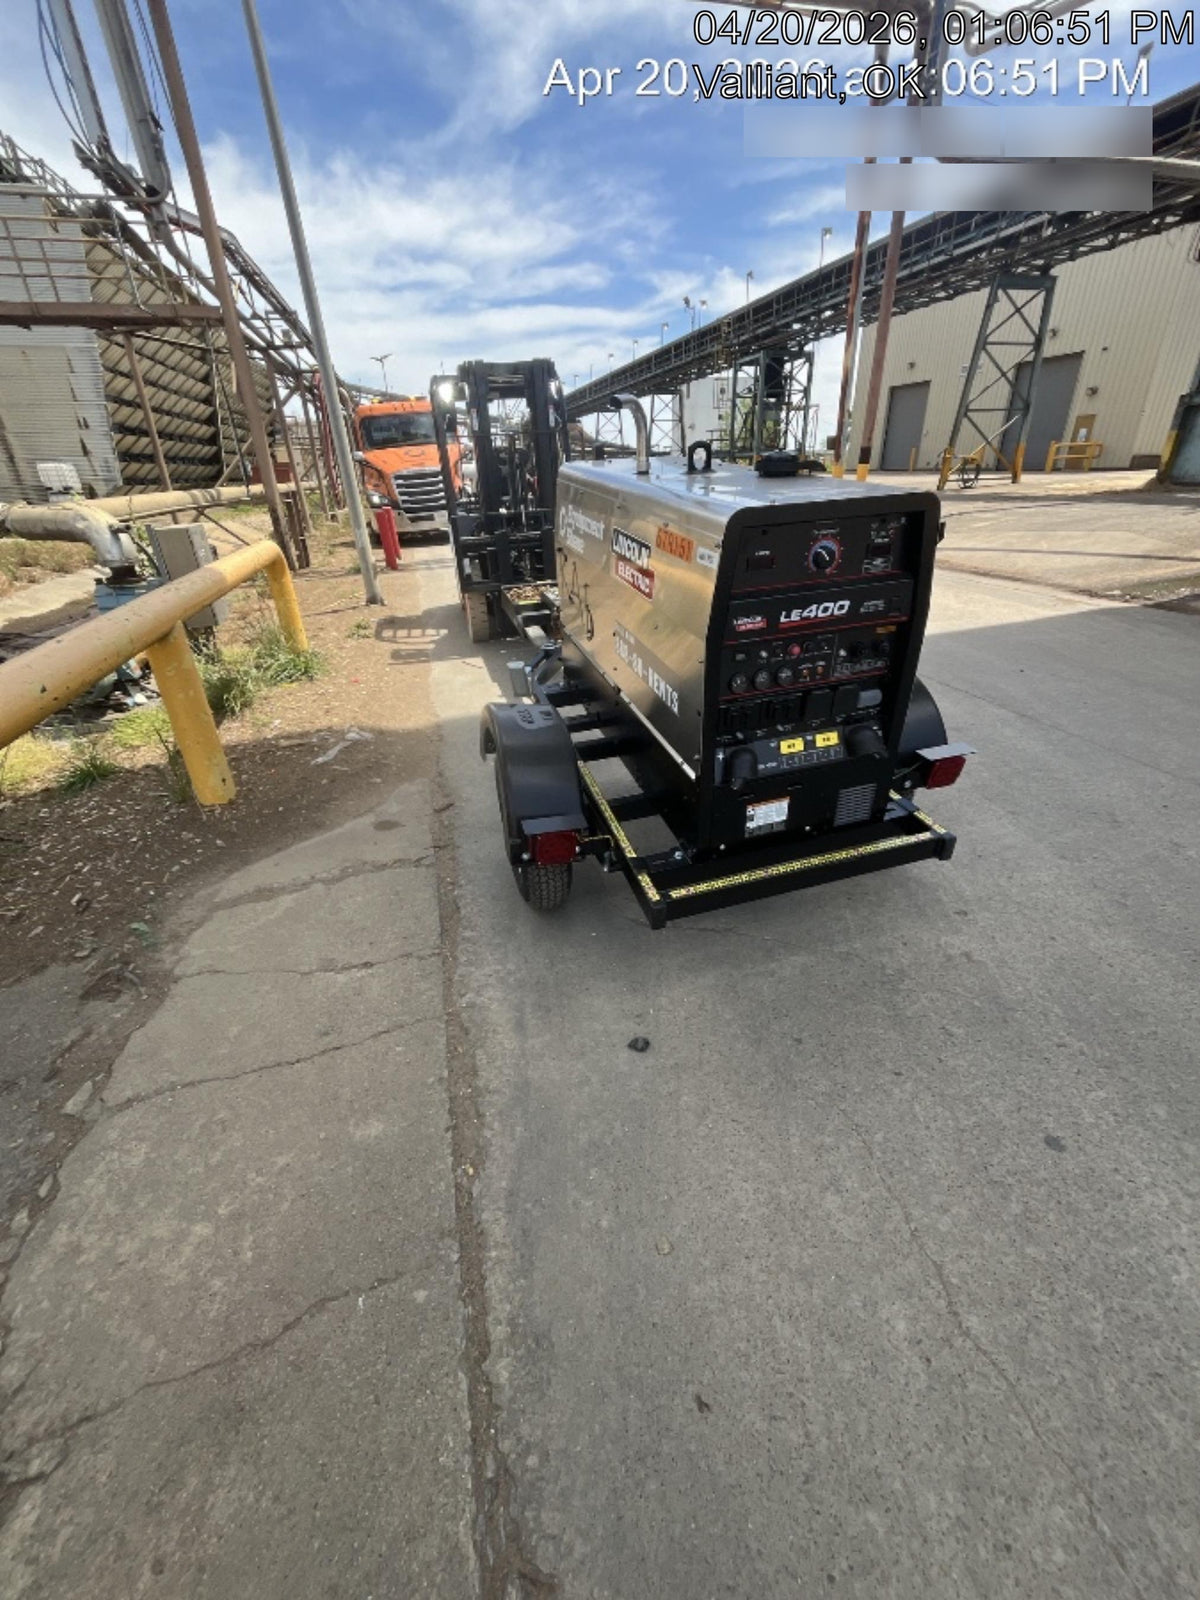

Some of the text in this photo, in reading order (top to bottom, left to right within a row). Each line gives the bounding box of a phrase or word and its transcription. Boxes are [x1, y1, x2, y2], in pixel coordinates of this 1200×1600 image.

[612, 532, 651, 570] LINCOLN
[617, 561, 651, 593] ELECTRIC
[780, 600, 850, 623] LE400
